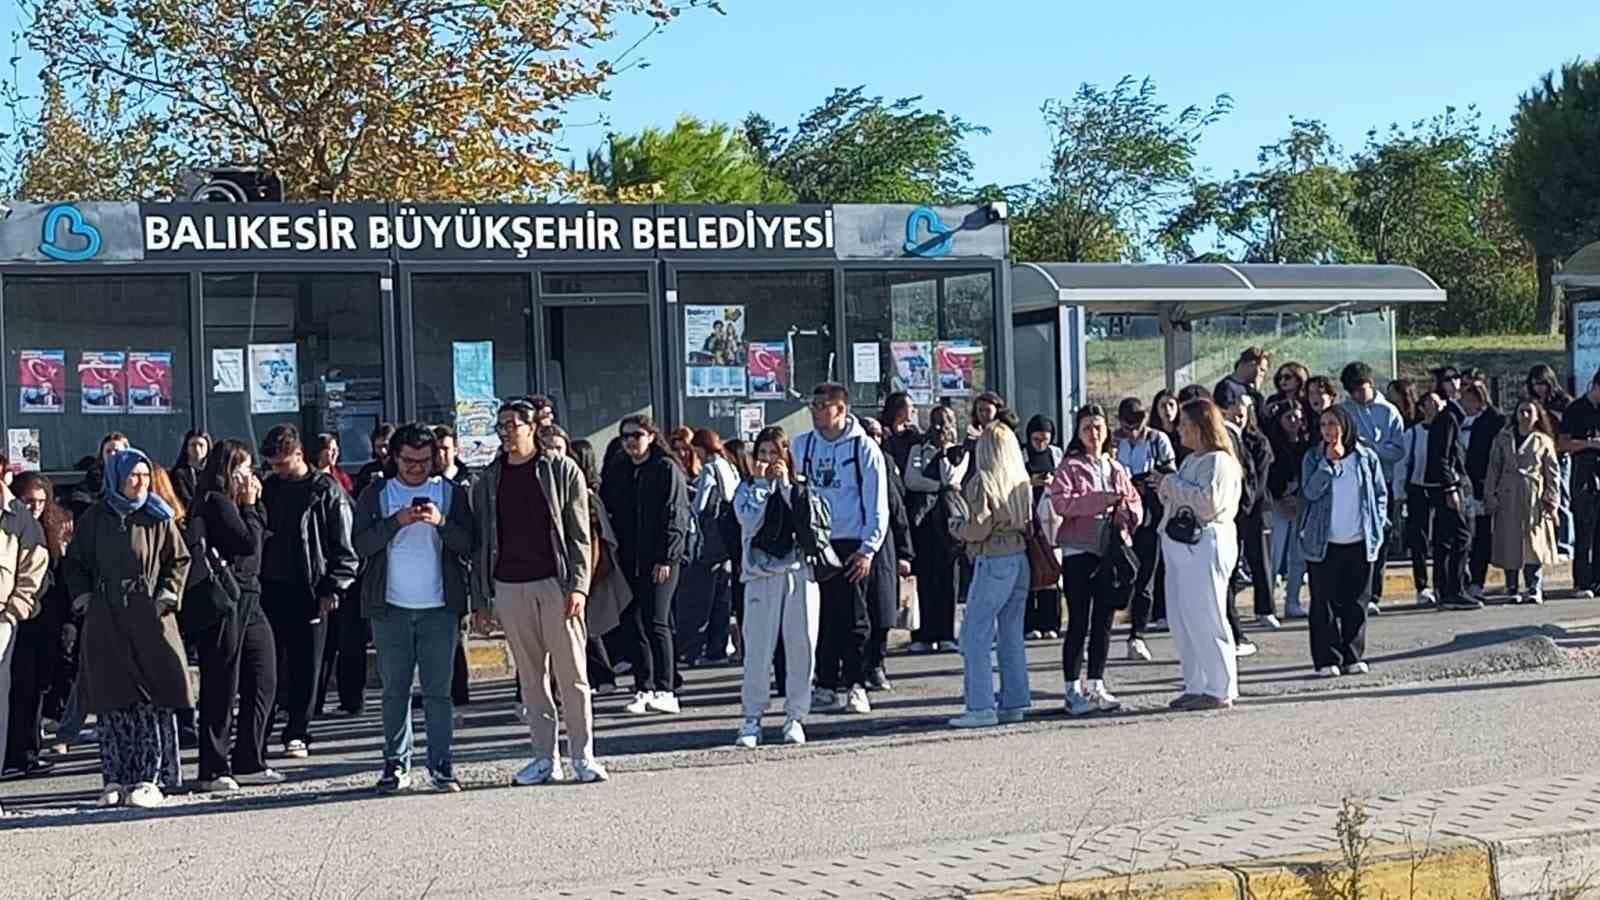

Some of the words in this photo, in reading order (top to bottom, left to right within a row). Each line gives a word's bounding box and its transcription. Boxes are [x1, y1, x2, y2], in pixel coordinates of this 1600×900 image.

[145, 209, 357, 250] BALIKESİR
[368, 208, 621, 258] BÜYÜKŞEHİR
[632, 209, 834, 249] BELEDİYESİ
